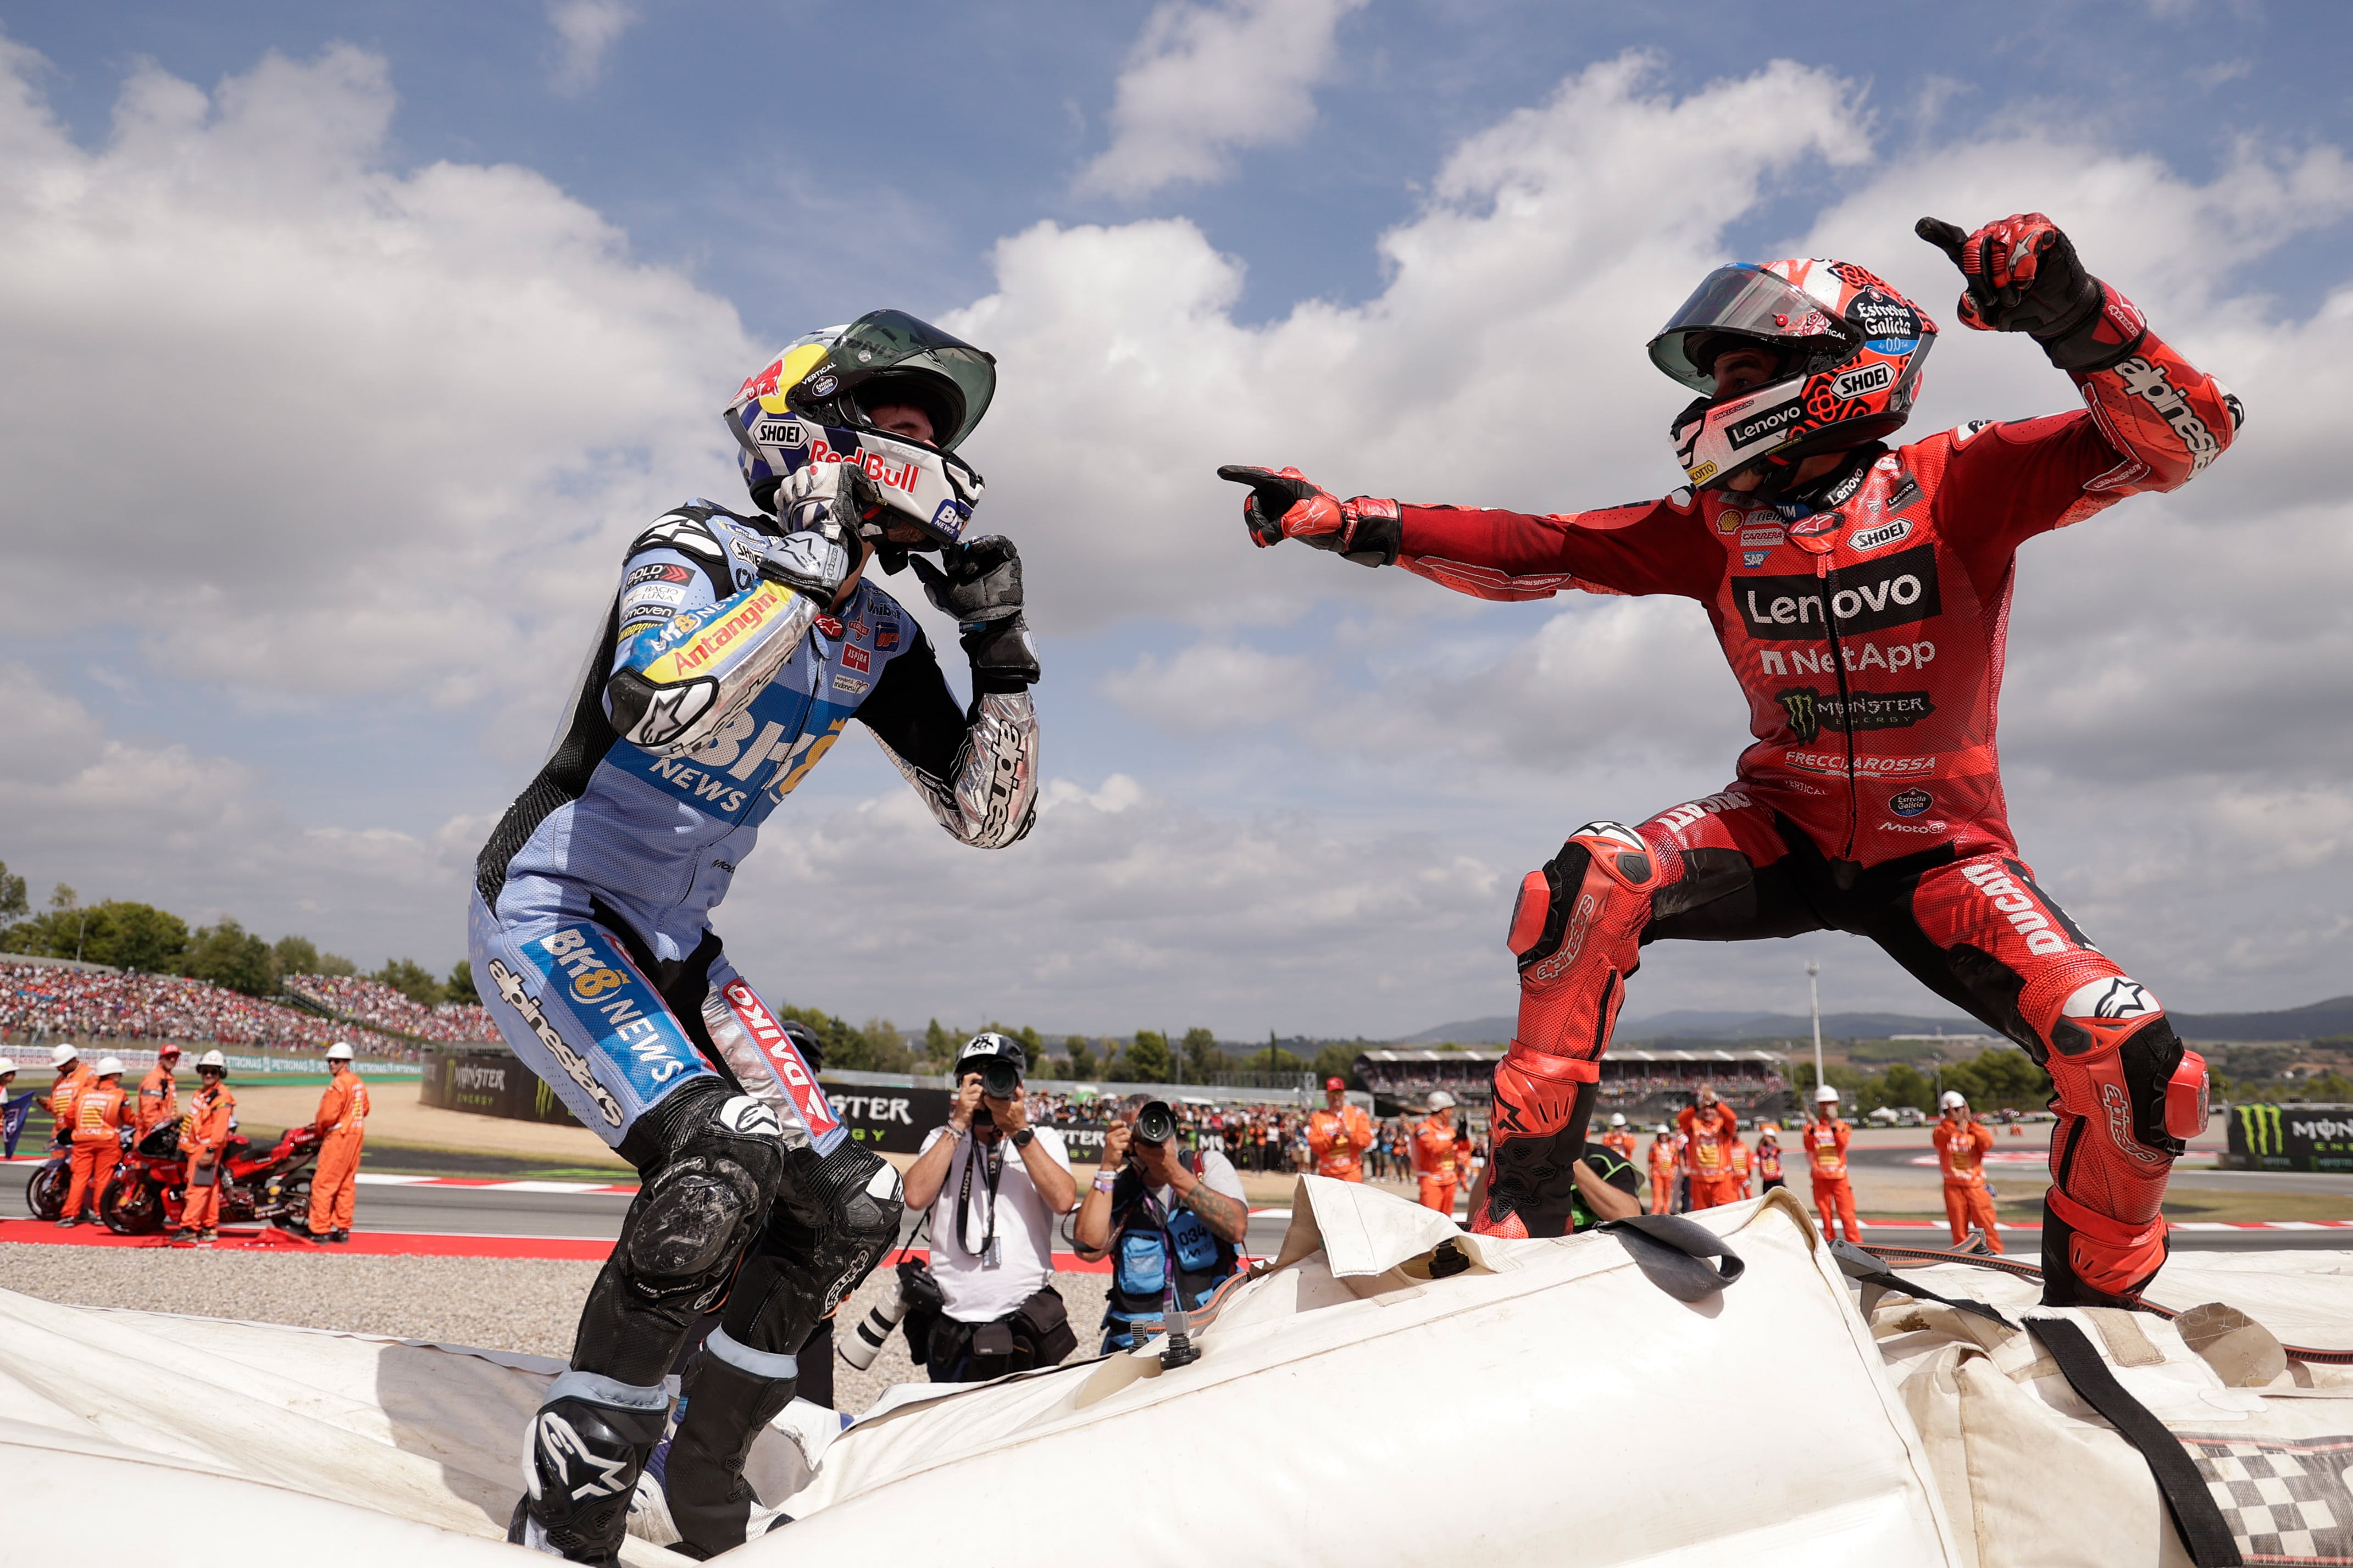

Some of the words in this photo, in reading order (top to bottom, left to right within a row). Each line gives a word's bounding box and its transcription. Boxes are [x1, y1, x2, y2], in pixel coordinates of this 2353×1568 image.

[1857, 302, 1910, 318] Estrella
[1824, 328, 1846, 340] TICAL
[1865, 318, 1911, 336] Galicia
[802, 362, 836, 385] VERTICAL
[1841, 368, 1888, 394] SHOEI
[1733, 407, 1800, 442] Lenovo
[2115, 357, 2221, 480] alpinesta
[759, 425, 800, 443] SHOEI
[891, 446, 923, 460] KAOS
[865, 453, 919, 493] Bull
[1828, 468, 1864, 505] Lenovo
[1889, 483, 1914, 504] Lenovo
[1776, 505, 1796, 518] TIM
[935, 519, 955, 535] NEWS
[1742, 532, 1783, 540] CARRERA
[1857, 522, 1904, 547] SHOEI
[1744, 554, 1764, 565] SAP
[628, 565, 663, 585] BOLD
[1747, 574, 1922, 624] Lenovo
[674, 592, 778, 676] Antangin
[847, 649, 868, 664] ASPIRA
[1792, 641, 1936, 675] NetApp
[1817, 697, 1926, 716] MONSTER
[1835, 715, 1911, 725] ENERGY
[1785, 751, 1936, 771] FRECCIAROSSA
[649, 757, 747, 812] NEWS
[1878, 821, 1946, 833] MotoGP
[489, 959, 624, 1128] alpinestars
[600, 998, 685, 1082] NEWS
[728, 985, 811, 1086] DAIKO
[454, 1064, 506, 1092] MONSTER
